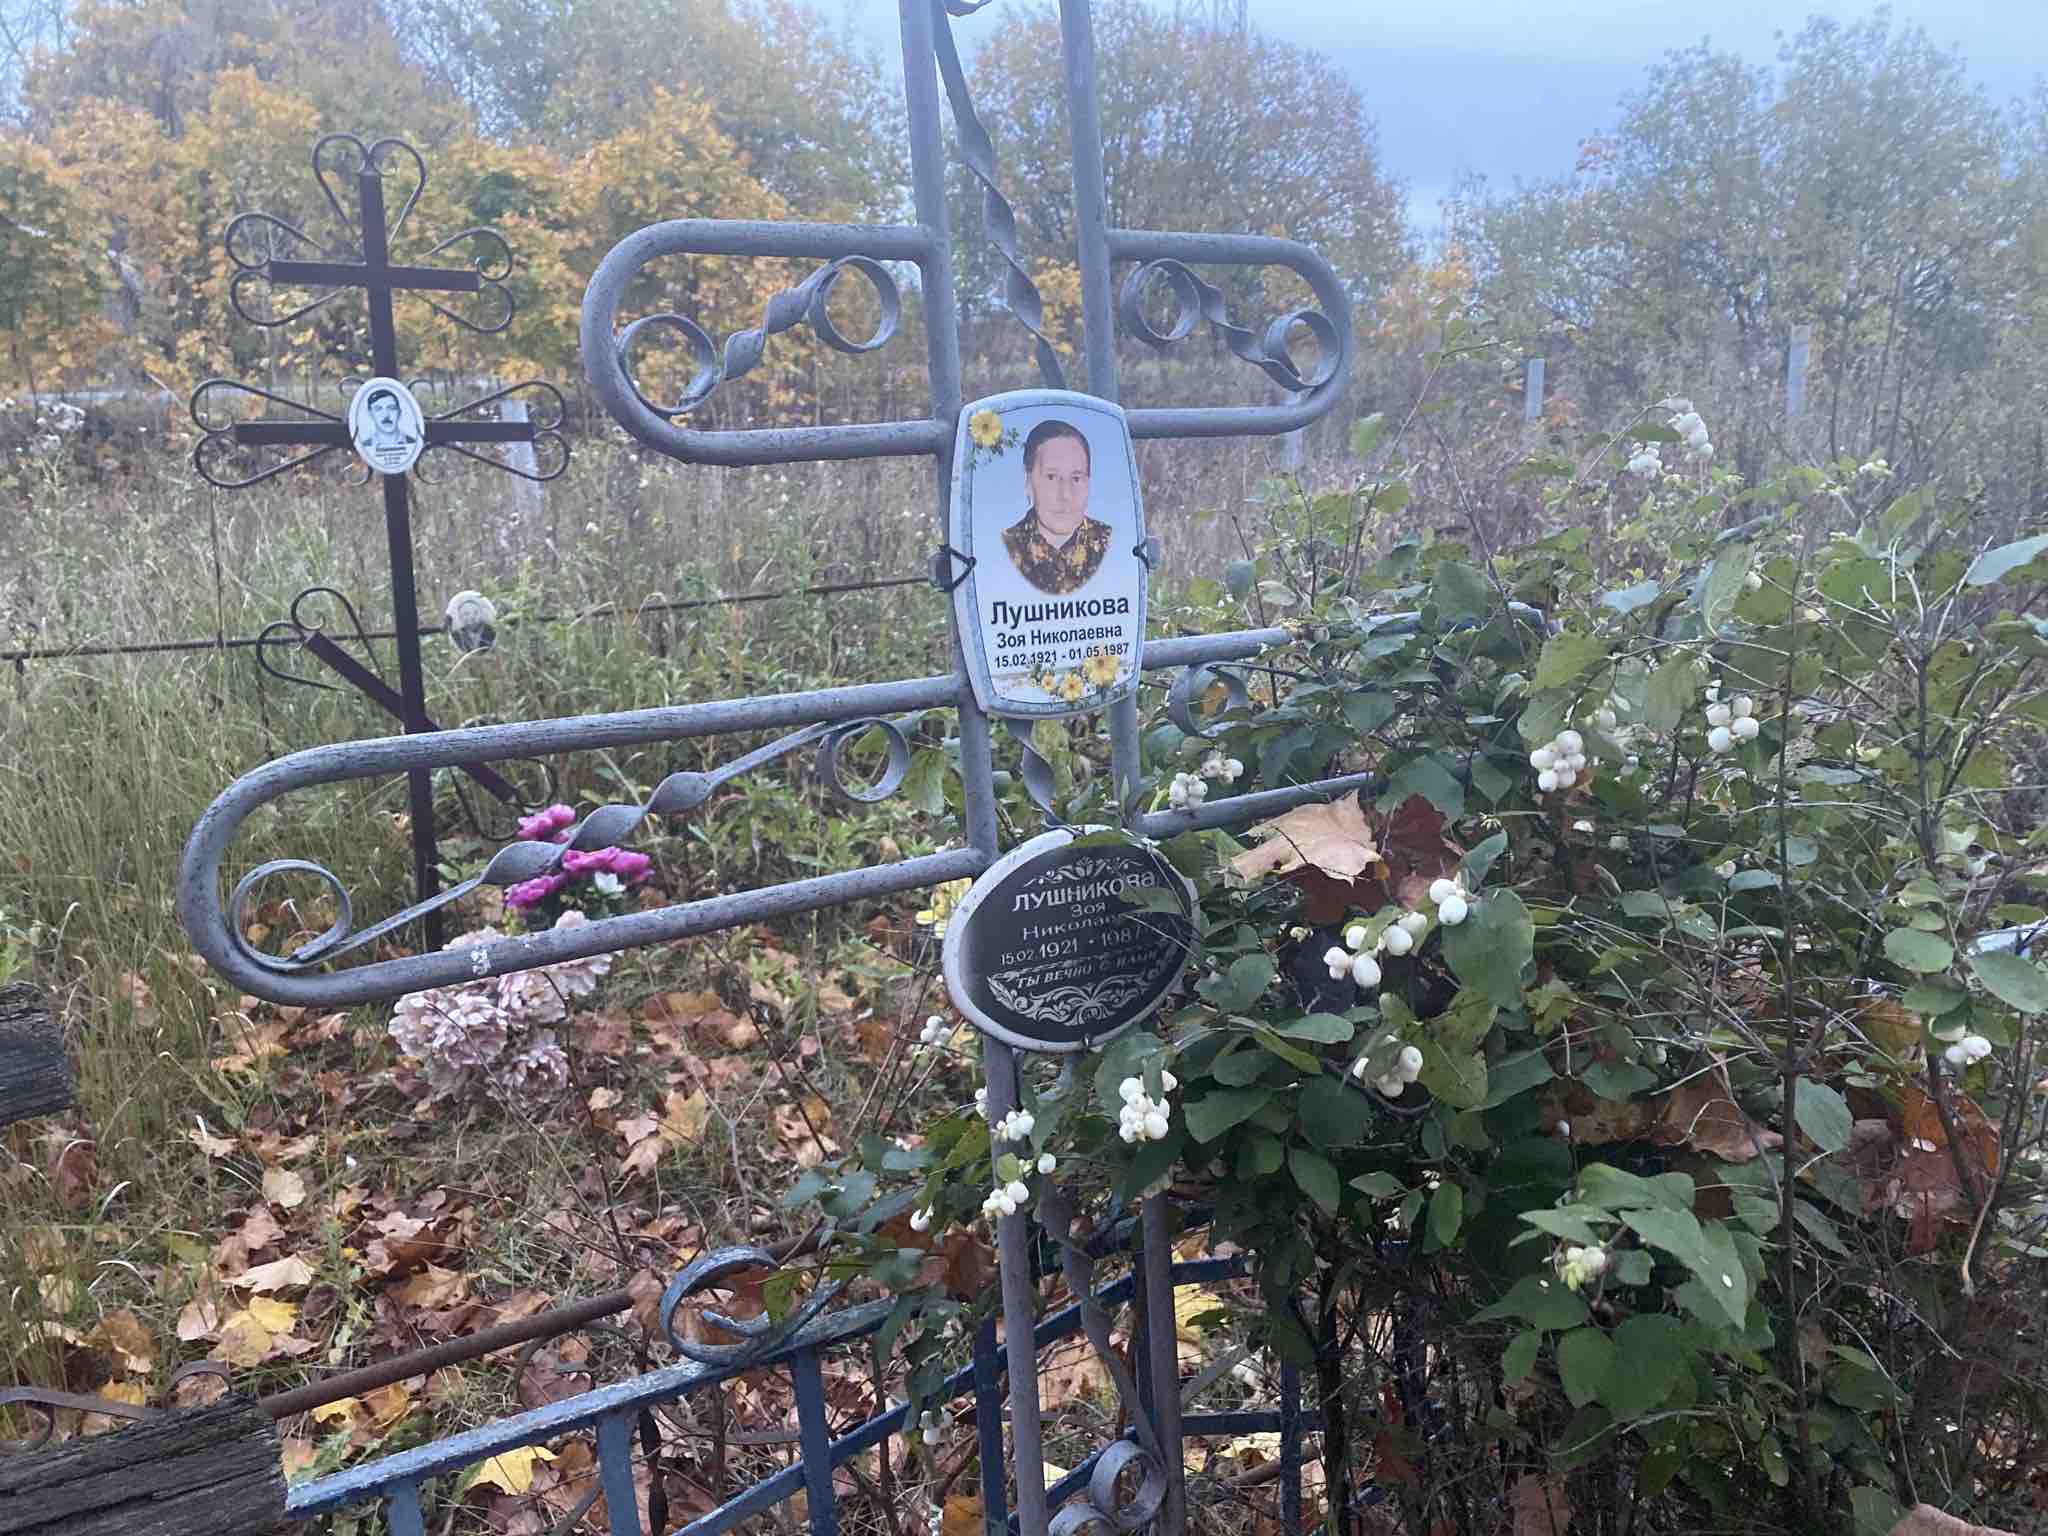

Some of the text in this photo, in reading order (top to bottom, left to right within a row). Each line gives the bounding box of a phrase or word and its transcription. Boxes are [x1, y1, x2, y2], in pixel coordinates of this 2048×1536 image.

[991, 596, 1129, 629] Лушникова
[997, 625, 1122, 649] Зоя Николаевна
[995, 650, 1057, 669] 15.02.1921
[1068, 642, 1129, 661] 01.05.1987
[1011, 872, 1155, 912] ЛУШНИКОВА
